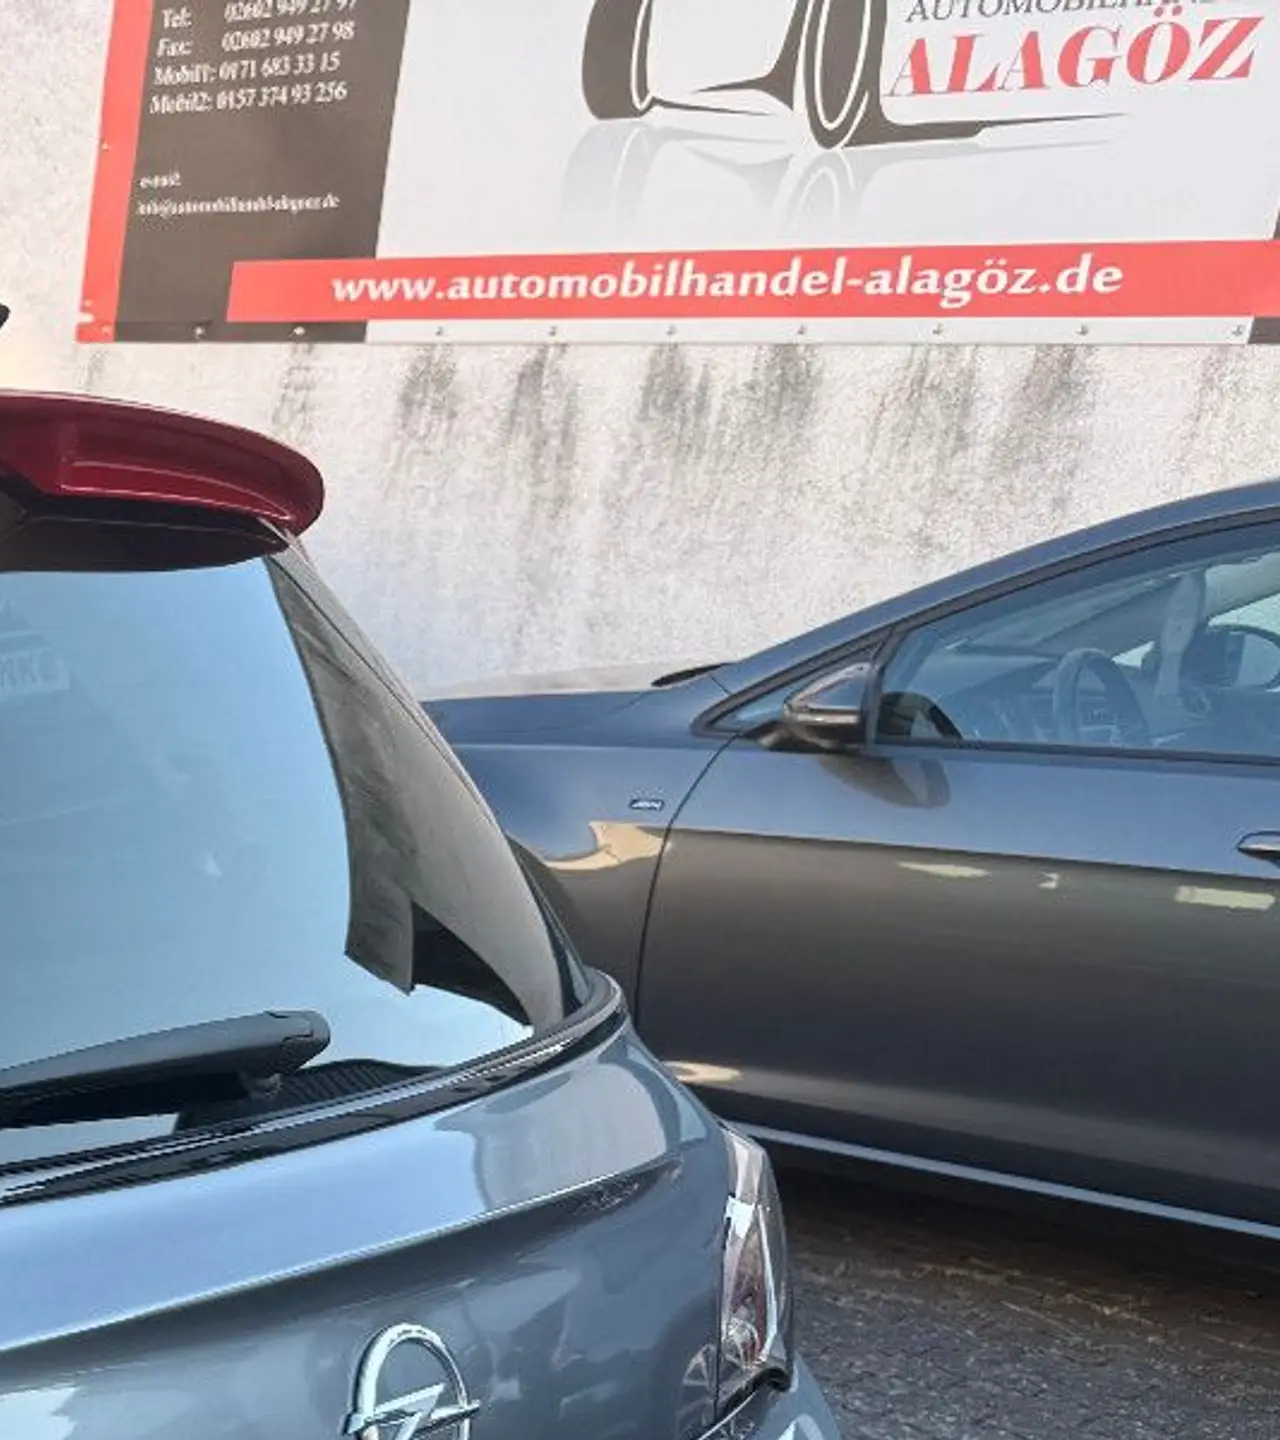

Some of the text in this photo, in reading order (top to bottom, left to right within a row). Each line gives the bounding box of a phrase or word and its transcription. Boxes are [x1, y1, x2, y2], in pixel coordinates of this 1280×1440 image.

[306, 23, 330, 43] 27
[332, 20, 356, 41] 98
[320, 51, 341, 73] 15
[884, 5, 1265, 97] ALAGÖZ
[314, 81, 348, 103] 256
[332, 252, 1123, 308] www.automobilhandel-alagöz.de
